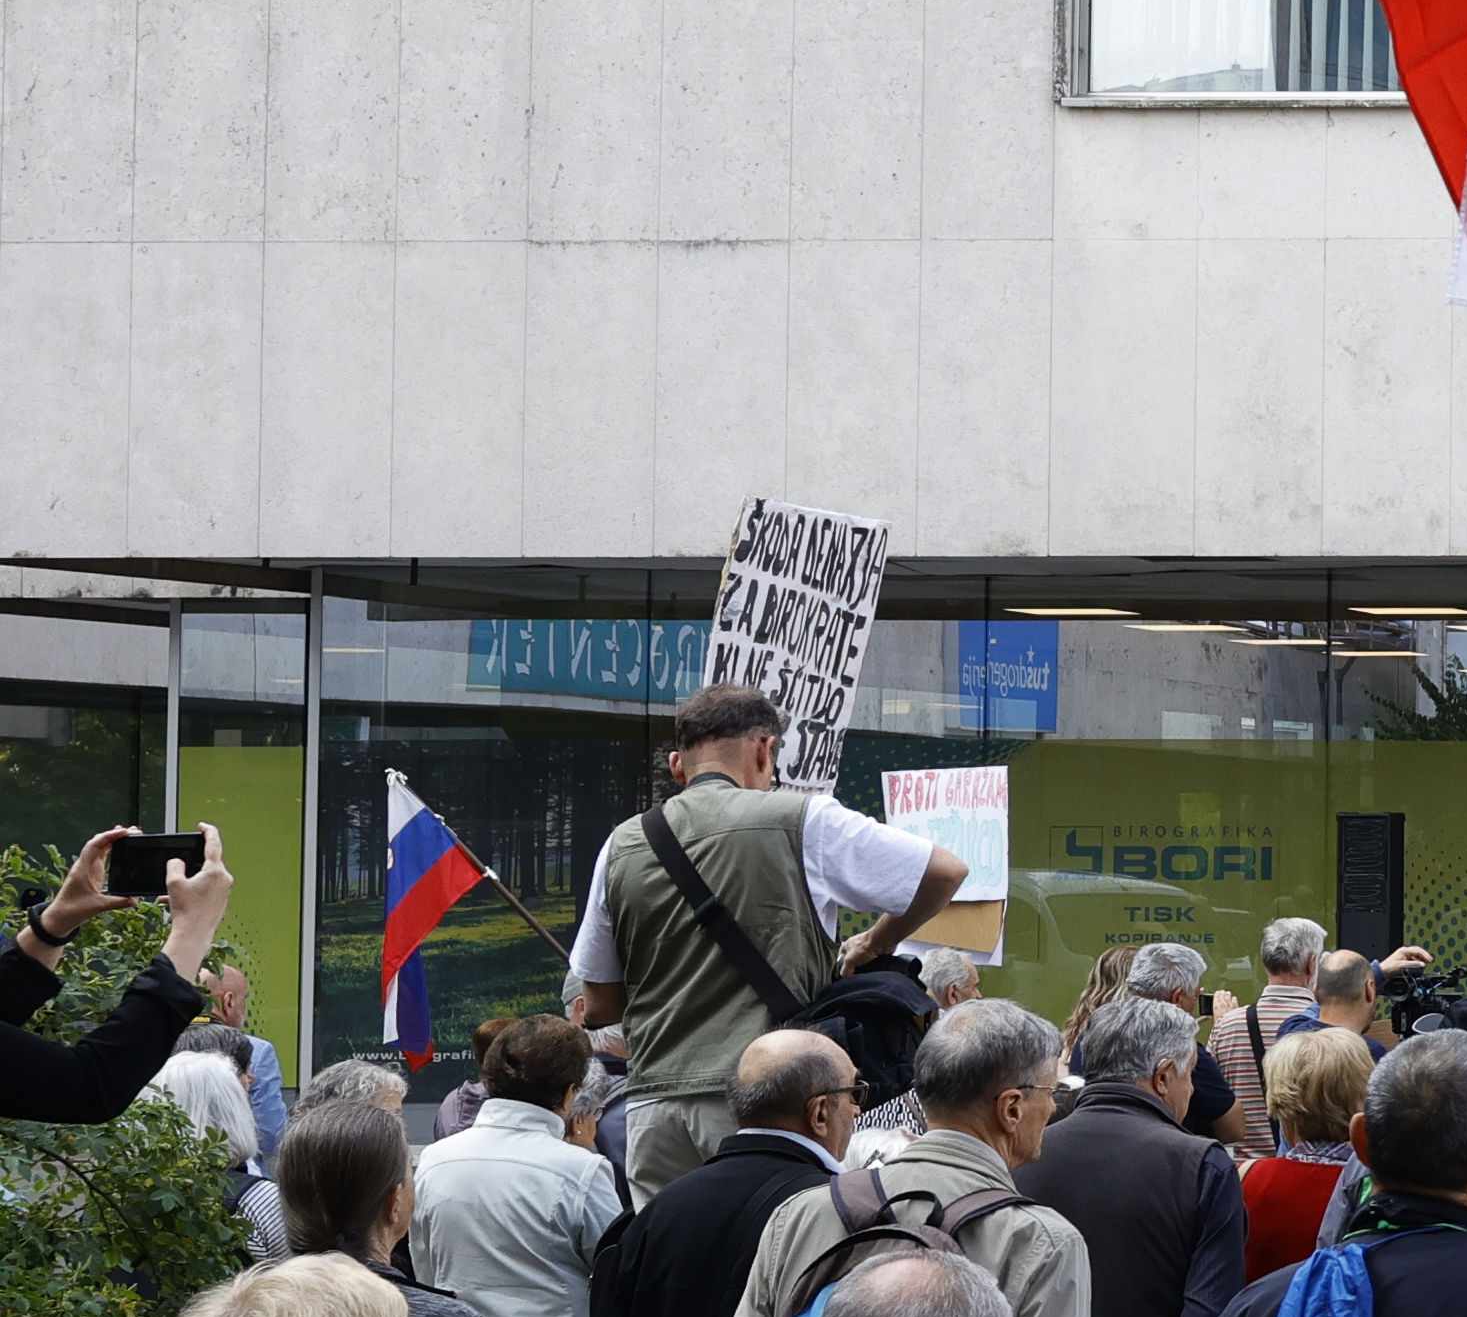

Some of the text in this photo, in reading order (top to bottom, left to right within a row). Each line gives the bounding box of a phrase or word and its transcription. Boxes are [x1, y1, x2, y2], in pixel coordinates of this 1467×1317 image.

[754, 583, 867, 688] BIROKRATE
[888, 774, 940, 817] PROTI
[1113, 825, 1273, 839] BIROGRAFIKA
[1113, 845, 1273, 881] BORI
[1124, 906, 1196, 922] TISK
[1105, 933, 1215, 944] KOPIRANJE
